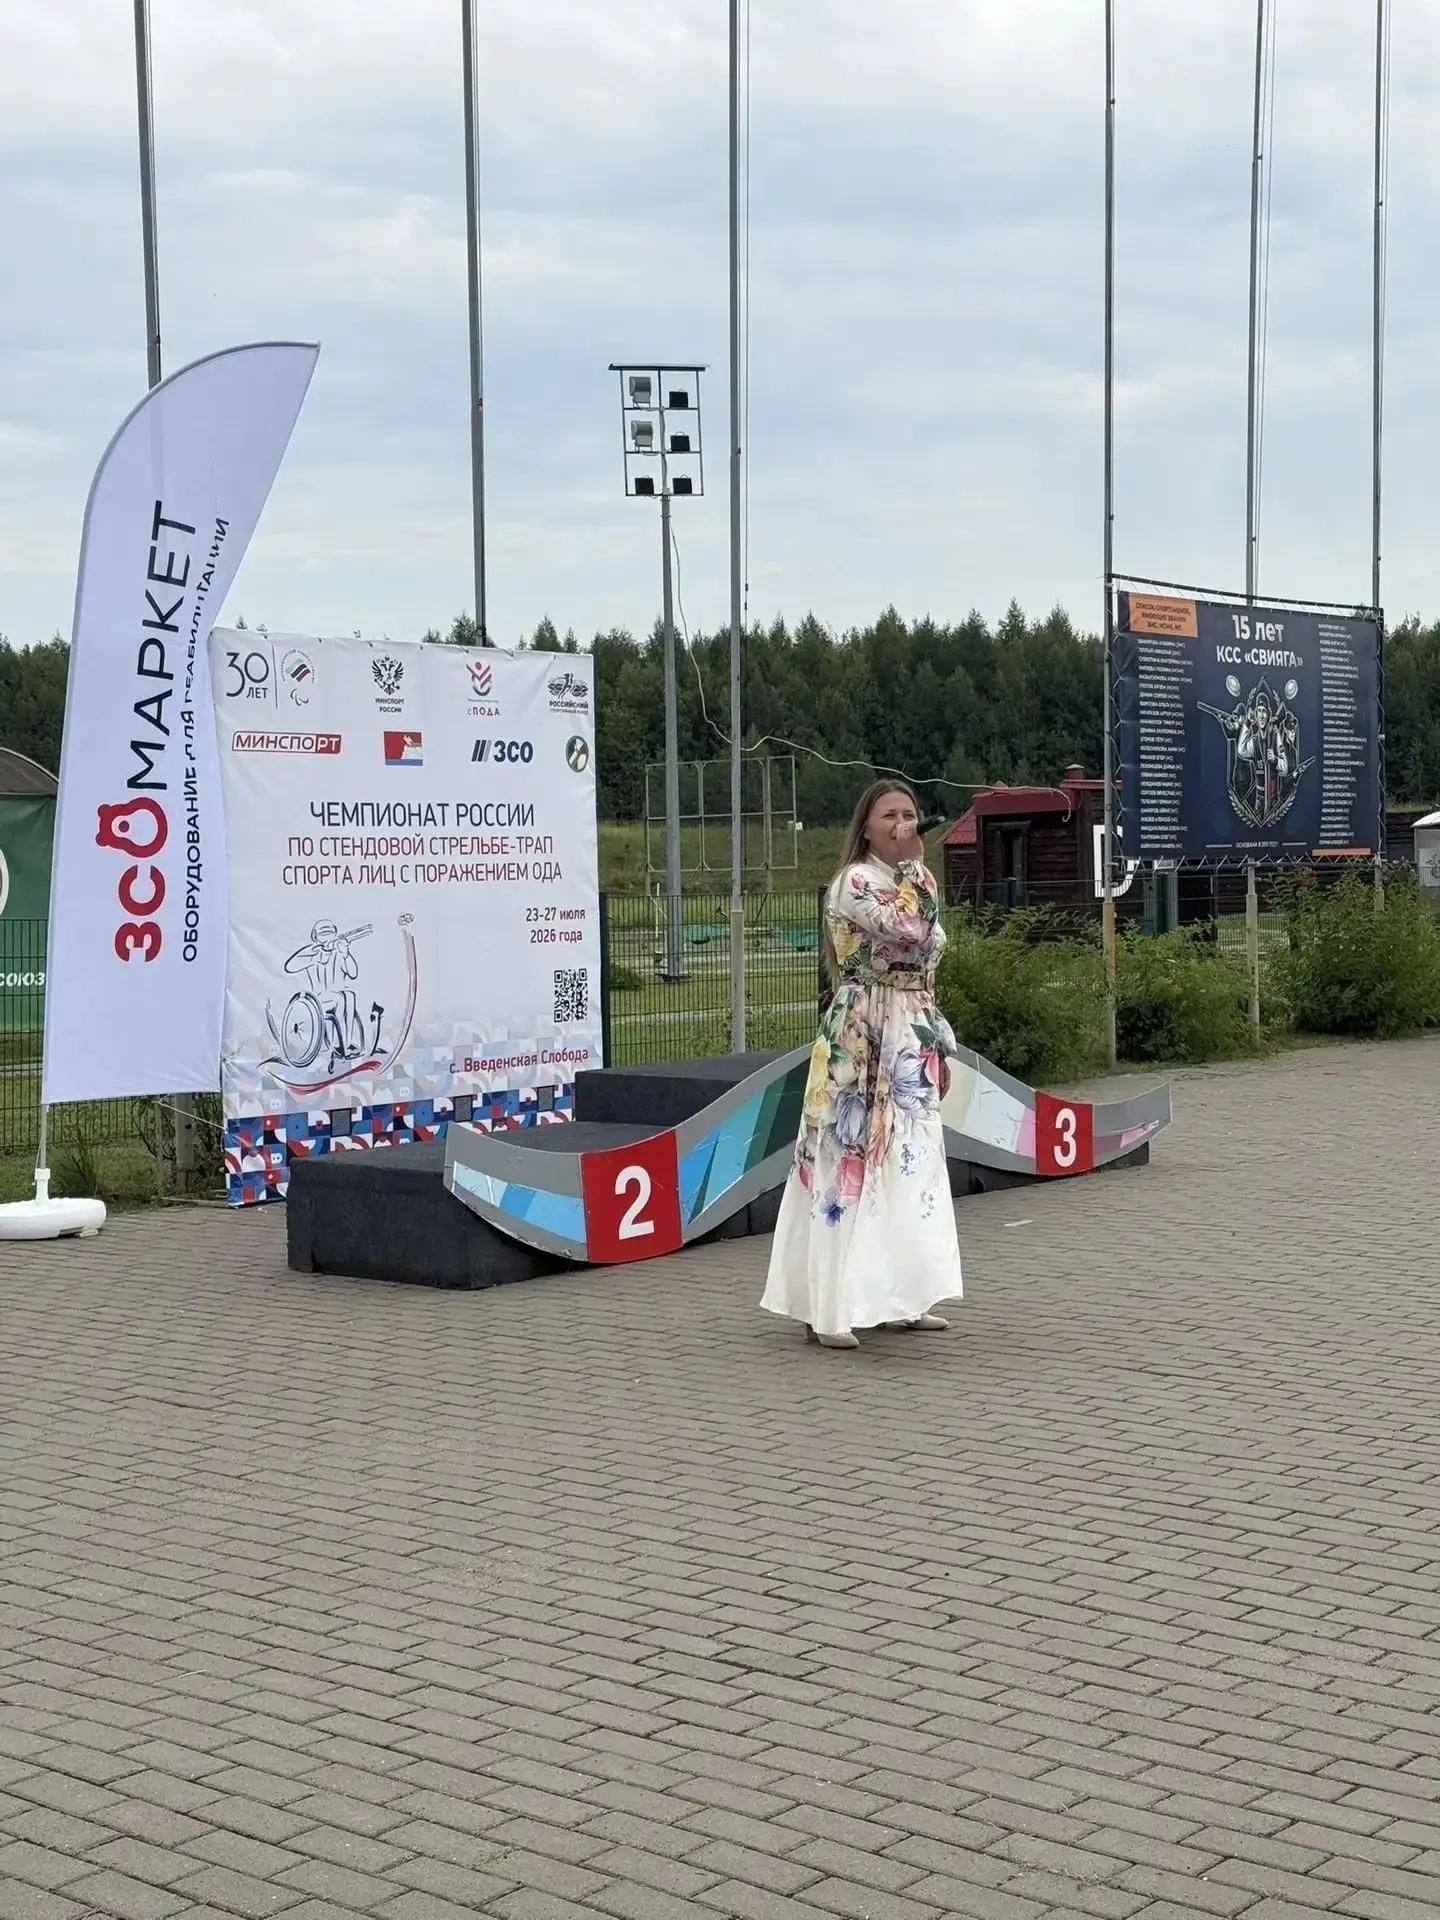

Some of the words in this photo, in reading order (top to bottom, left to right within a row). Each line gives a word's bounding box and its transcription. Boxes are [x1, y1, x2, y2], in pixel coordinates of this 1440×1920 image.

[1231, 614, 1250, 639] 15
[1255, 621, 1284, 642] лет
[1216, 645, 1241, 664] КСС
[1244, 647, 1303, 667] «СВИЯГА»
[226, 652, 269, 697] 30
[246, 687, 268, 699] ЛЕТ
[236, 734, 340, 751] МИНСПОРТ
[310, 801, 449, 827] ЧЕМПИОНАТ
[456, 803, 535, 827] РОССИИ
[288, 837, 314, 856] ПО
[319, 832, 425, 860] СТЕНДОВОЙ
[429, 836, 553, 855] СТРЕЛЬБЕ-ТРАП
[283, 865, 354, 885] СПОРТА
[358, 864, 396, 887] ЛИЦ
[400, 864, 410, 883] С
[415, 862, 529, 883] ПОРАЖЕНИЕМ
[532, 862, 563, 883] ОДА
[525, 907, 557, 922] 23-27
[559, 908, 586, 920] июля
[530, 928, 556, 943] 2026
[559, 931, 583, 943] года
[449, 1062, 460, 1074] с.
[464, 1055, 538, 1073] Введенская
[541, 1048, 589, 1065] Слобода
[1053, 1108, 1076, 1168] 3
[615, 1165, 655, 1240] 2
